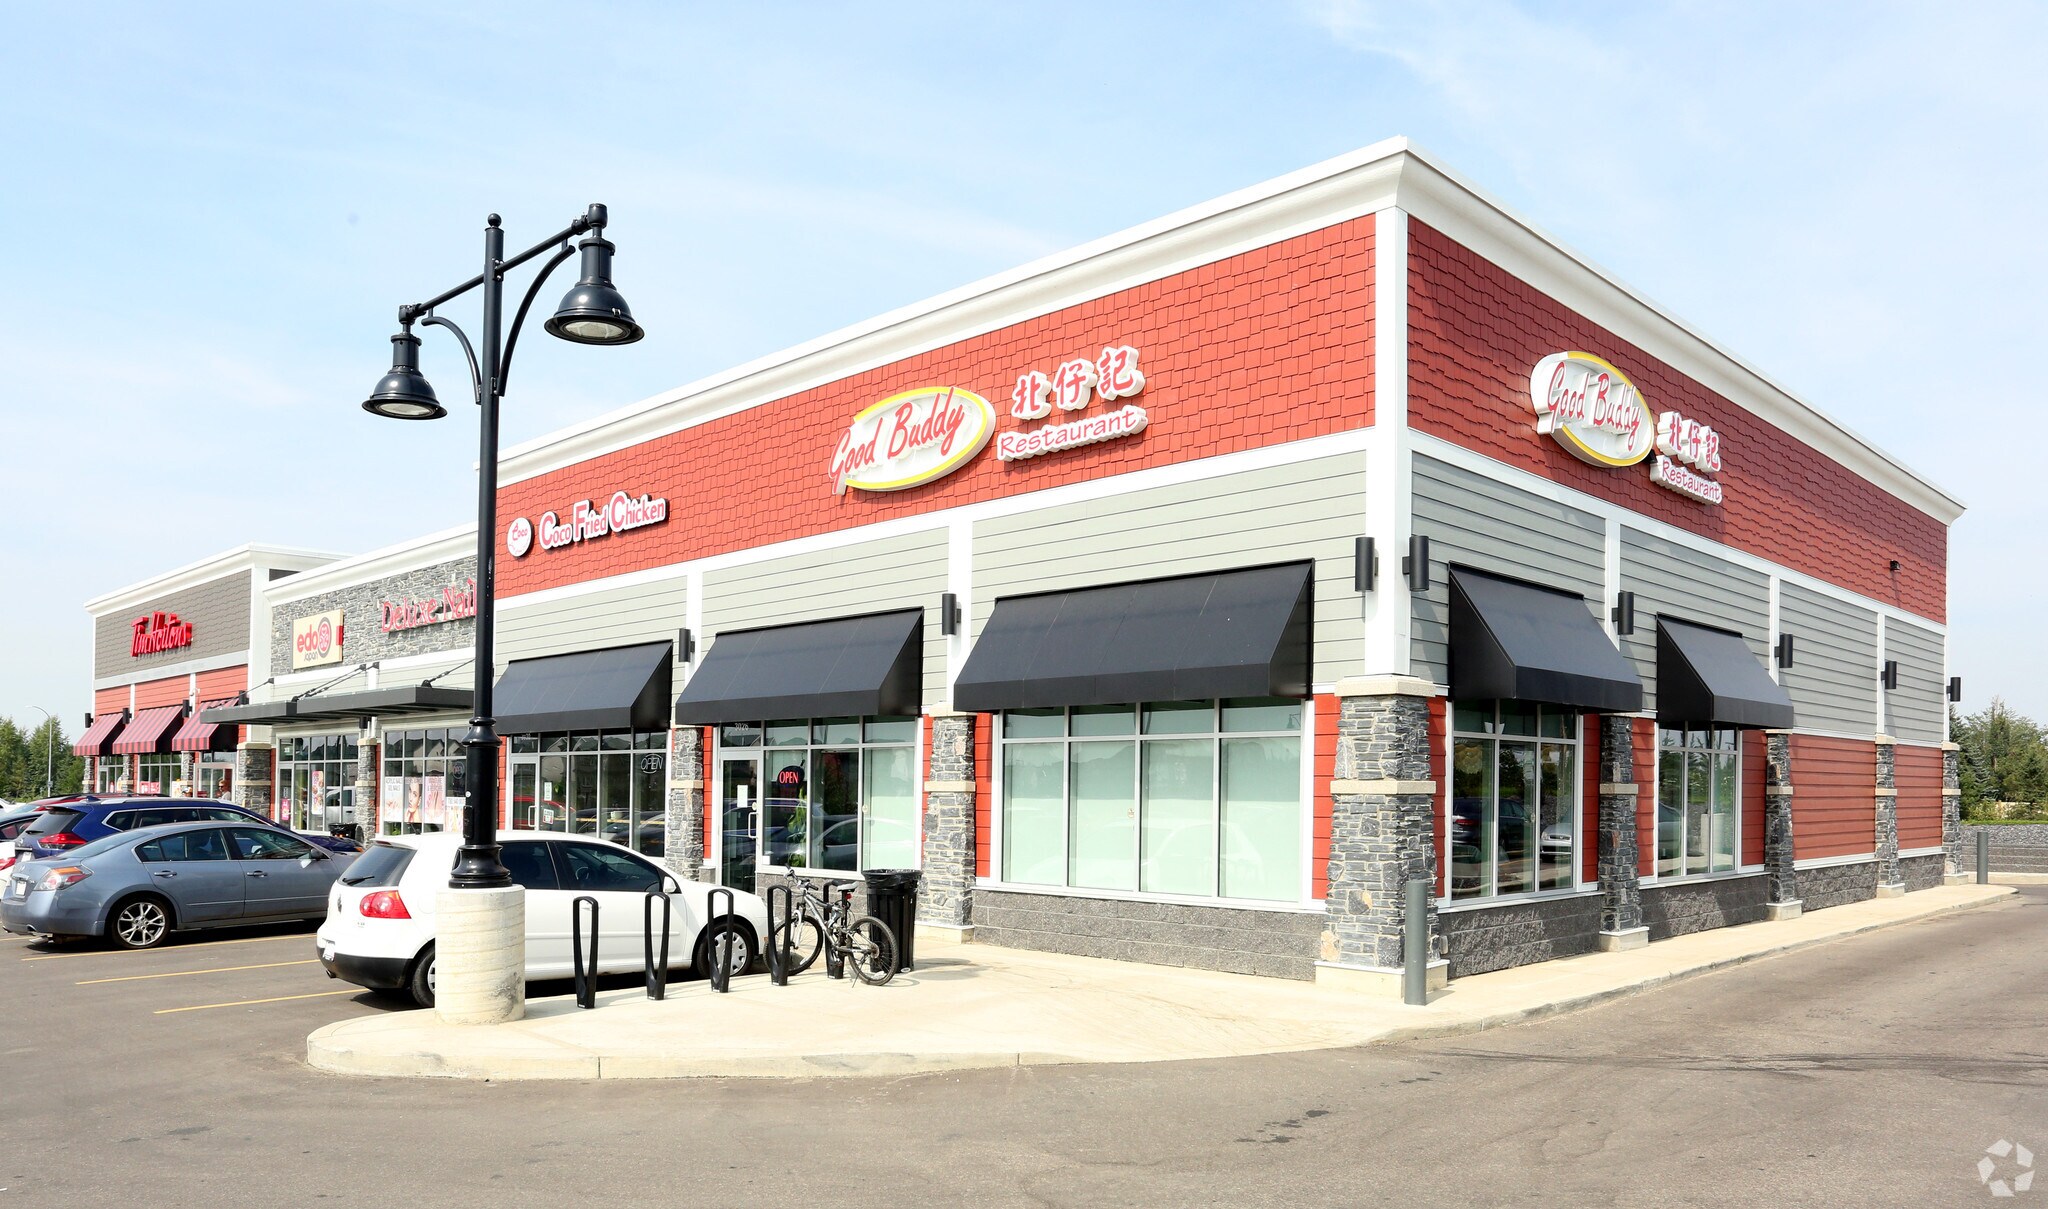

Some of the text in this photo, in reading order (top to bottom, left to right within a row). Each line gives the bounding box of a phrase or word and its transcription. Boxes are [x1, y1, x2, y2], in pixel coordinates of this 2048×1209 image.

[1013, 349, 1136, 415] 北仔記
[1547, 361, 1641, 452] Good Buddy
[828, 387, 966, 494] Good Buddy
[1000, 408, 1138, 457] Restaurant
[1669, 413, 1721, 470] 北仔記
[1662, 460, 1721, 501] Restaurant
[541, 494, 665, 547] Coco Fried Chicken
[381, 577, 478, 633] Deluxe Nail
[130, 616, 152, 657] Tim
[297, 624, 318, 653] edo
[640, 757, 663, 771] OPEN
[779, 771, 799, 784] OPEN
